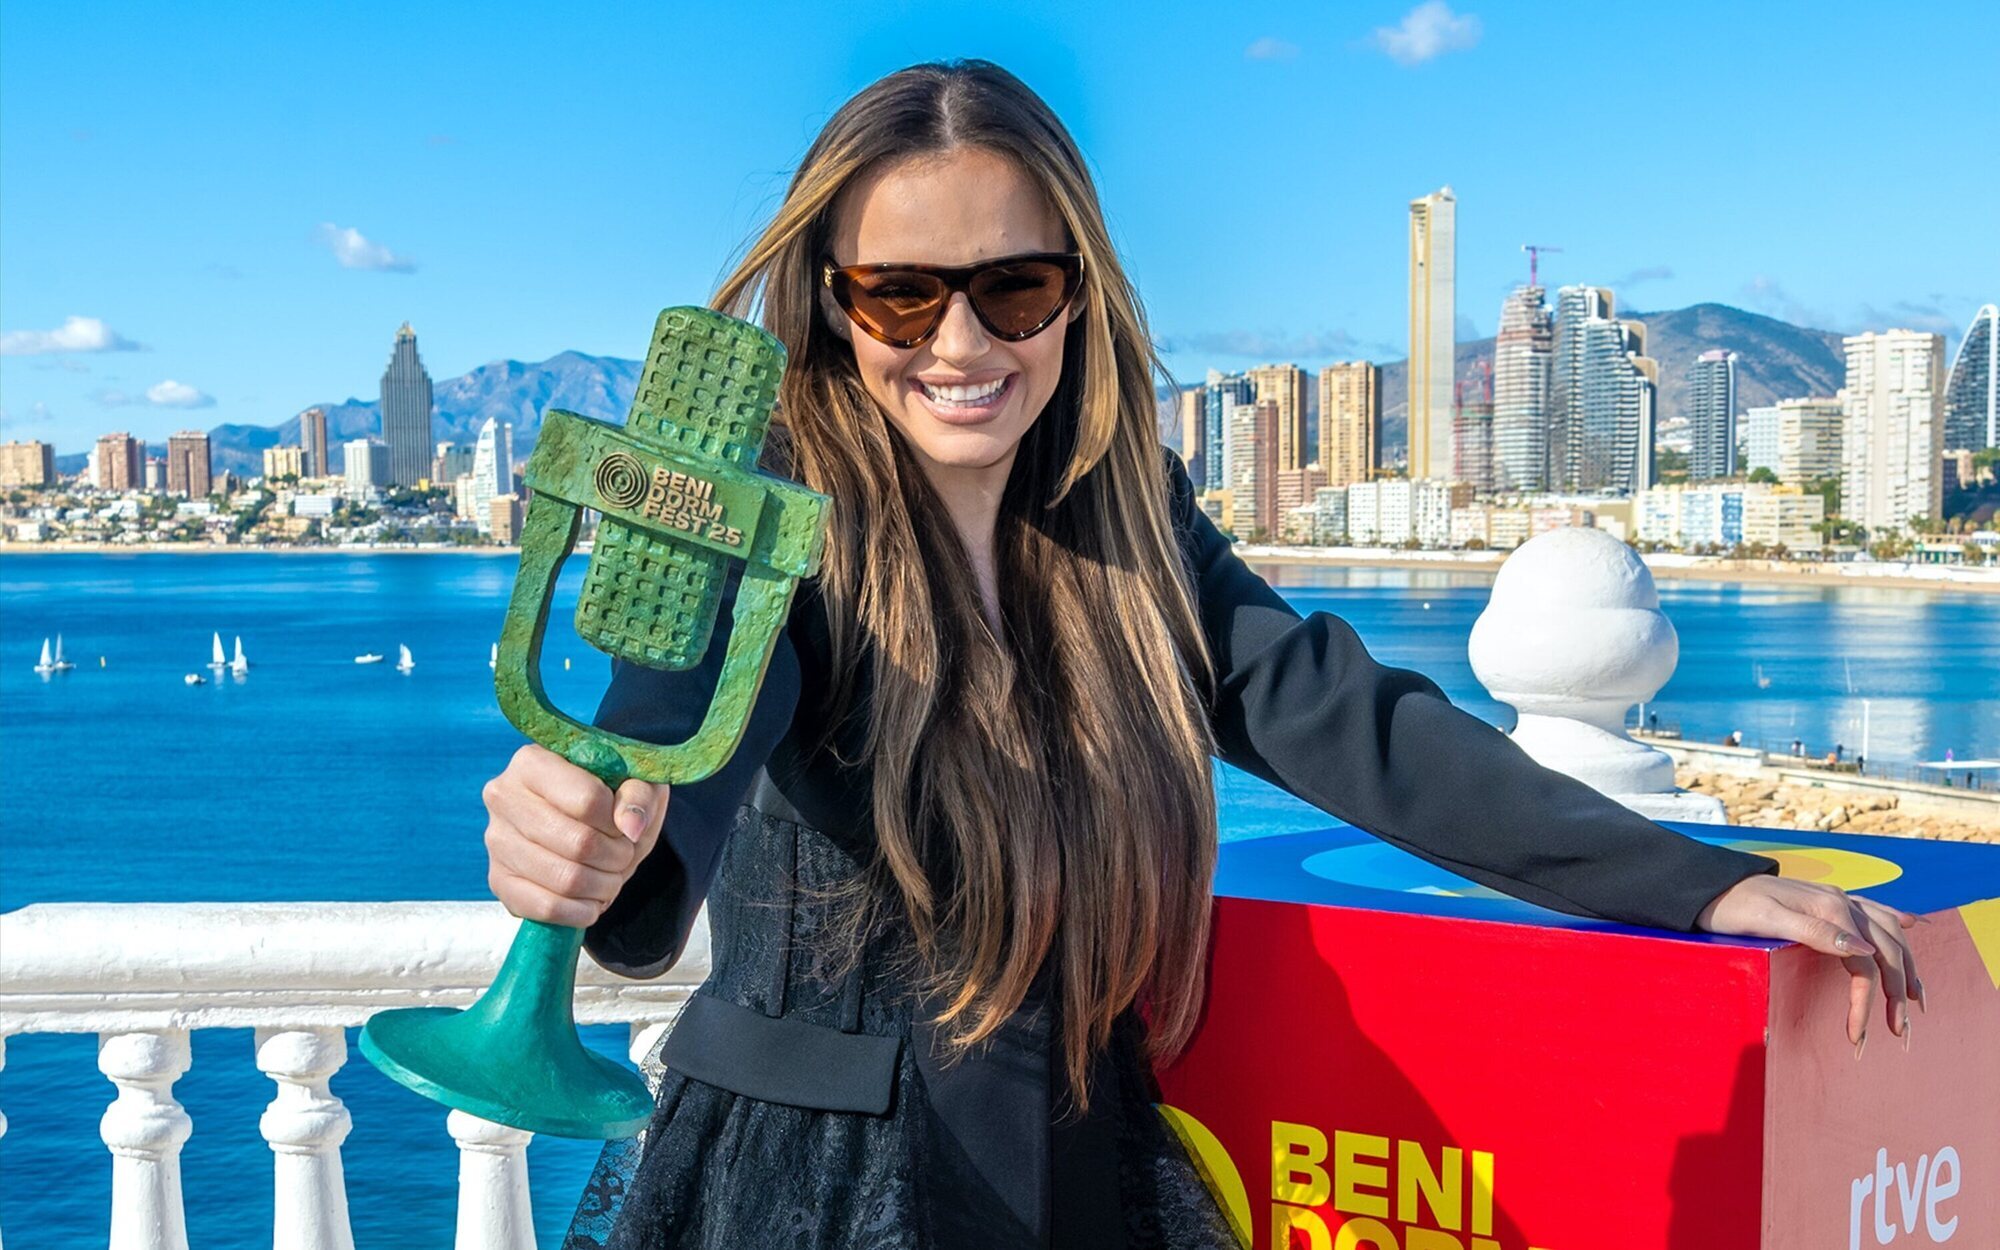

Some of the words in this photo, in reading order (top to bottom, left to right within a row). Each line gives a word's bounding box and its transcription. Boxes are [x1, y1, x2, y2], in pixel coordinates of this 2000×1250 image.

[649, 484, 723, 522] DORM
[653, 467, 713, 500] BENI
[1271, 1121, 1494, 1236] BENI
[1850, 1146, 1961, 1250] rtve
